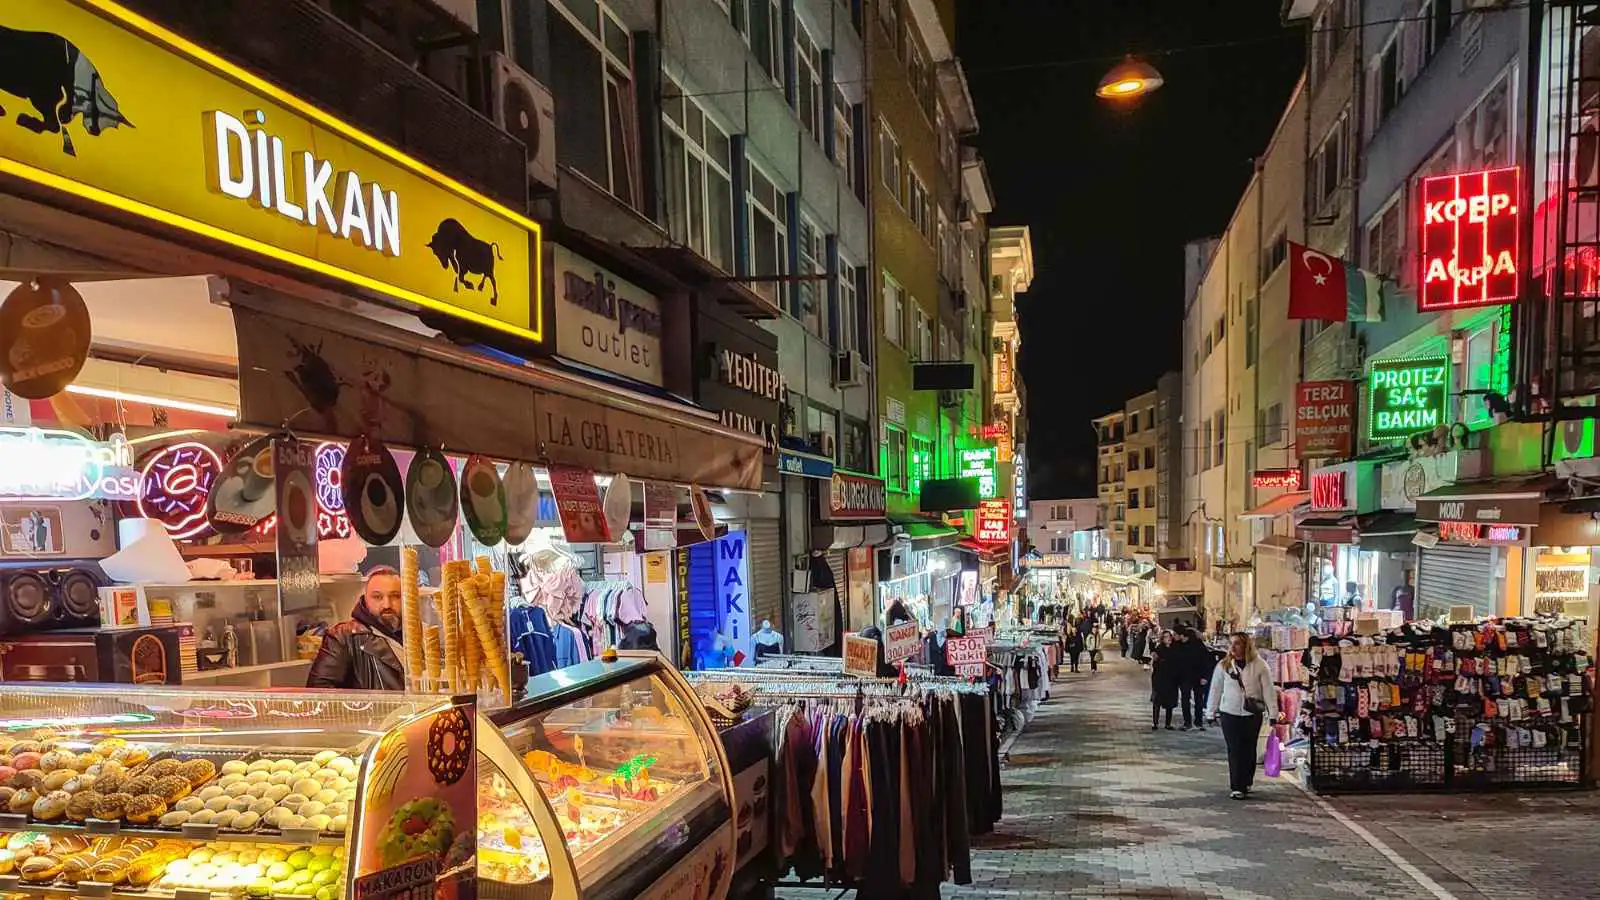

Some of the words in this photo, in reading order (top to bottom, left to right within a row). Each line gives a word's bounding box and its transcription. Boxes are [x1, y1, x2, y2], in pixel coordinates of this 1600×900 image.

[214, 109, 400, 257] DİLKAN
[582, 325, 650, 368] outlet
[723, 348, 788, 403] YEDİTEPE
[1373, 367, 1445, 389] PROTEZ
[1303, 383, 1345, 401] TERZİ
[1388, 386, 1428, 408] SAÇ
[1298, 403, 1350, 423] SELÇUK
[1377, 408, 1437, 430] BAKIM
[545, 413, 574, 447] LA
[581, 420, 673, 463] GELATERIA
[840, 480, 869, 510] BURGER
[869, 483, 885, 511] KING
[213, 511, 257, 525] ESPRESSO
[949, 652, 985, 661] Nakit
